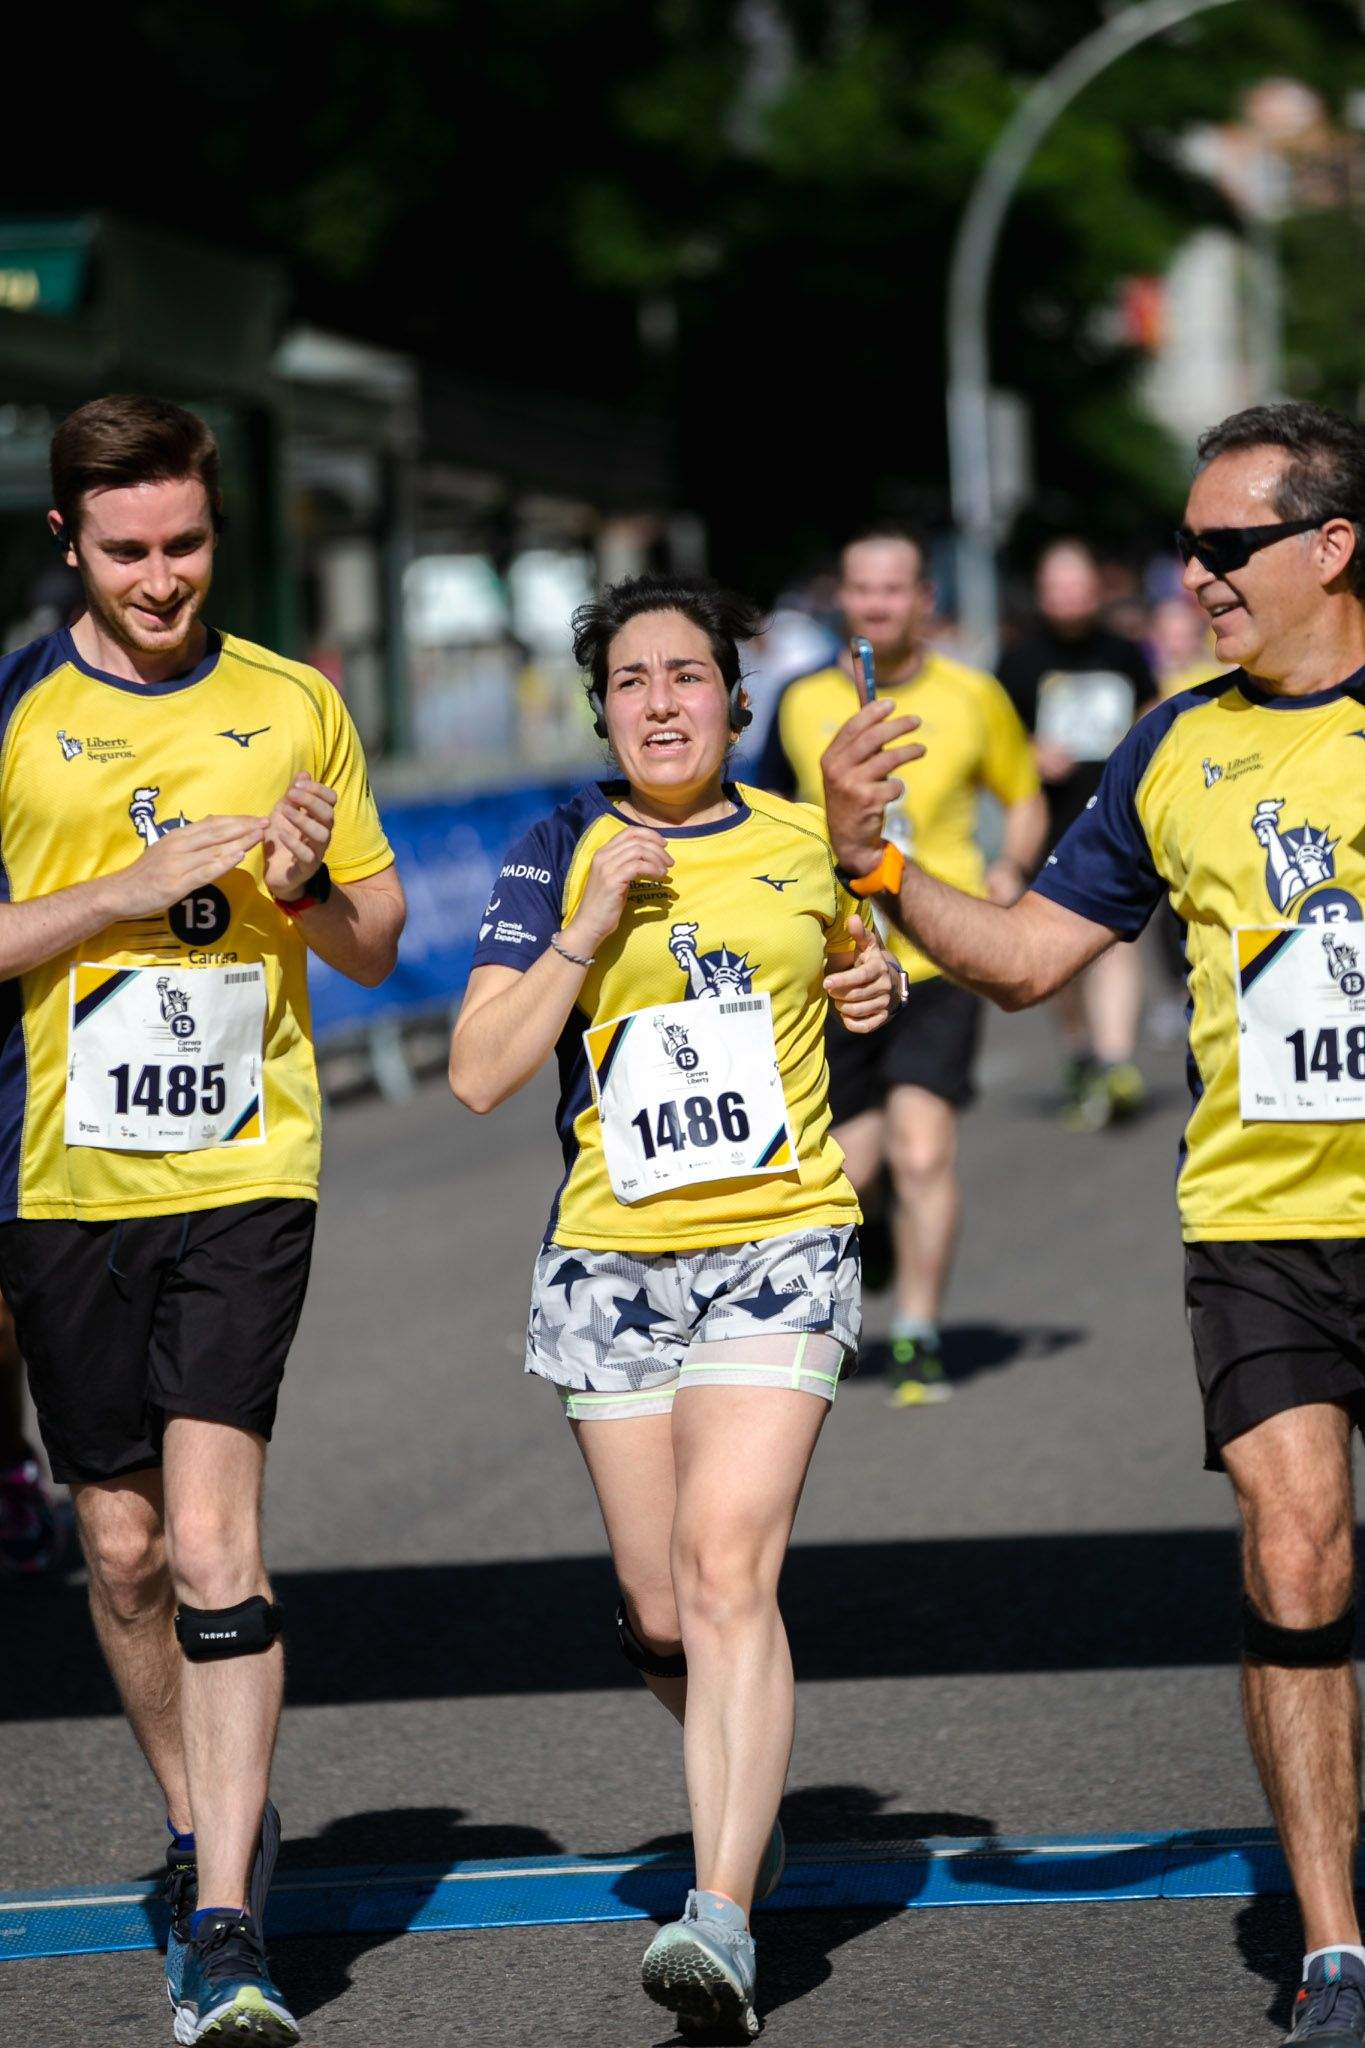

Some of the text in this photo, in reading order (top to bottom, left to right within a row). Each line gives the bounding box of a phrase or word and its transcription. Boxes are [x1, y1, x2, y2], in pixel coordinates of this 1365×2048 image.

[86, 736, 128, 749] Liberty
[500, 864, 551, 884] MADRID
[181, 898, 217, 929] 13
[174, 1019, 193, 1034] 13
[177, 1046, 201, 1054] Liberty
[678, 1052, 696, 1067] 13
[107, 1062, 226, 1117] 1485
[630, 1091, 750, 1160] 1486
